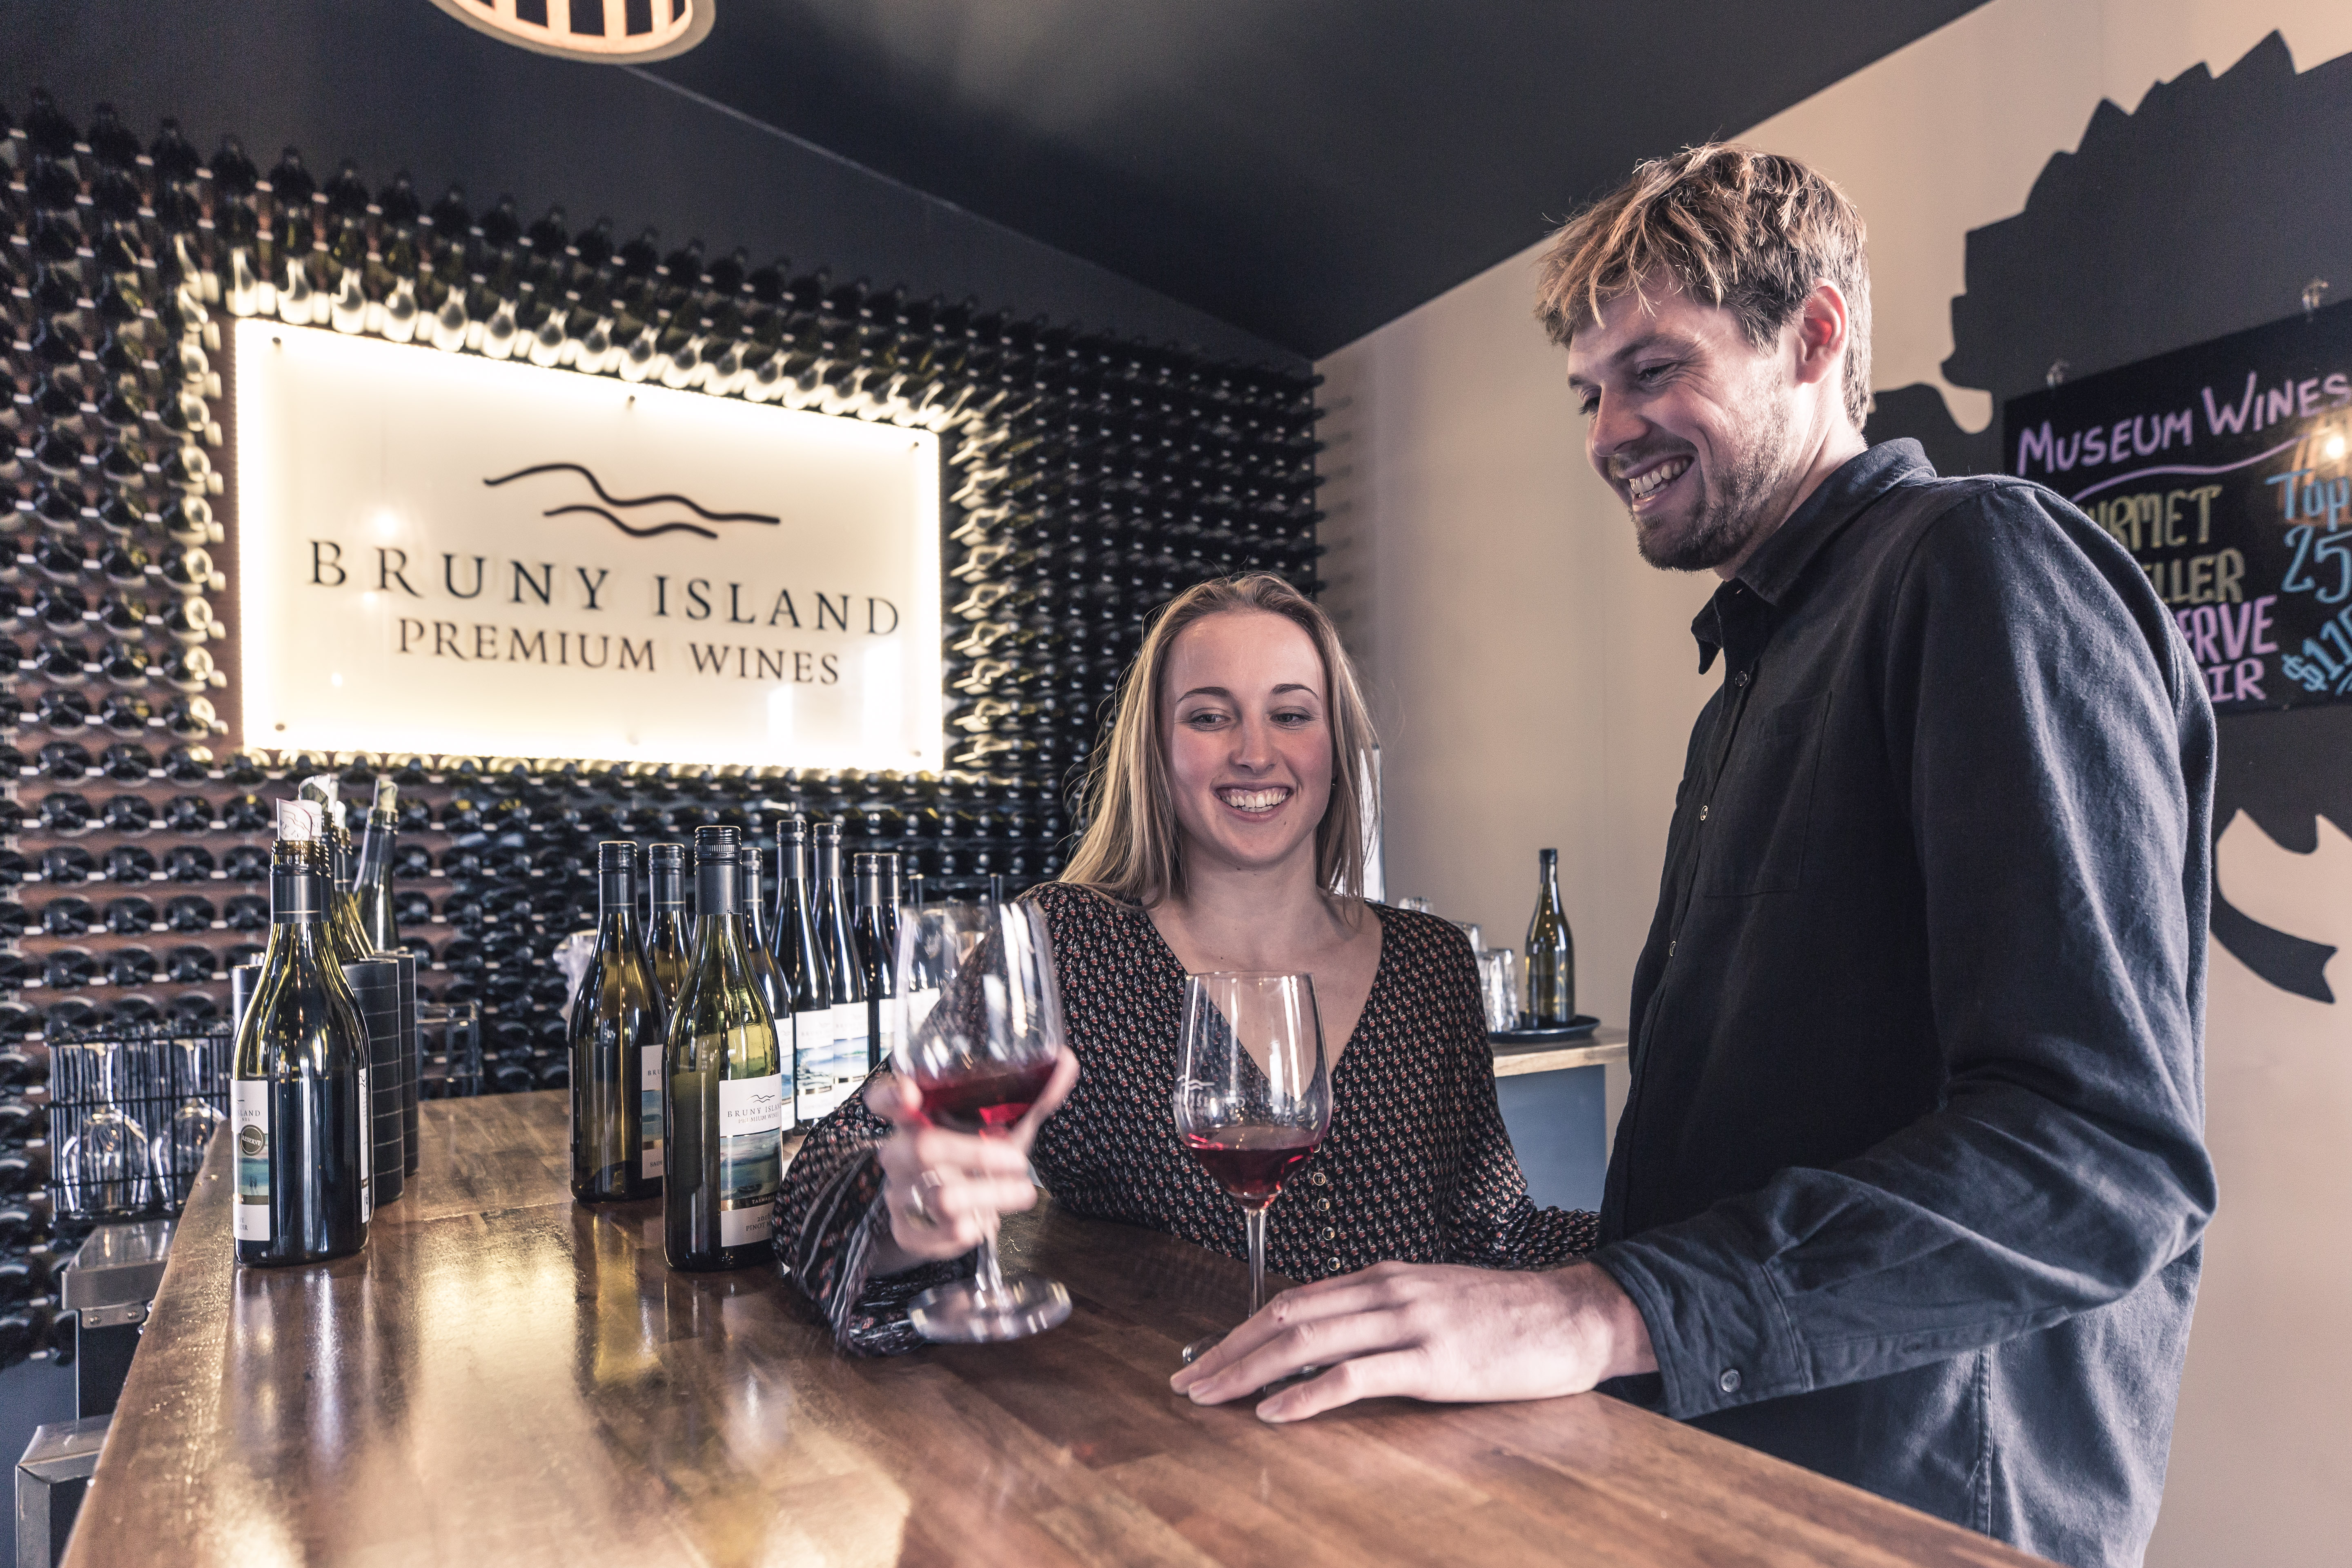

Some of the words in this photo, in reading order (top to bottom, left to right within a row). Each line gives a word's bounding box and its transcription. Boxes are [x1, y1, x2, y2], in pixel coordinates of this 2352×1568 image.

[2017, 410, 2193, 477] MUSEUM
[2203, 371, 2352, 436] WINES
[308, 539, 610, 610] BRUNY
[654, 575, 899, 635] ISLAND
[398, 617, 656, 673] PREMIUM
[689, 642, 839, 685] WINES
[2203, 657, 2266, 703] IR
[728, 1107, 761, 1118] BRUNY
[746, 1223, 765, 1232] PINOT
